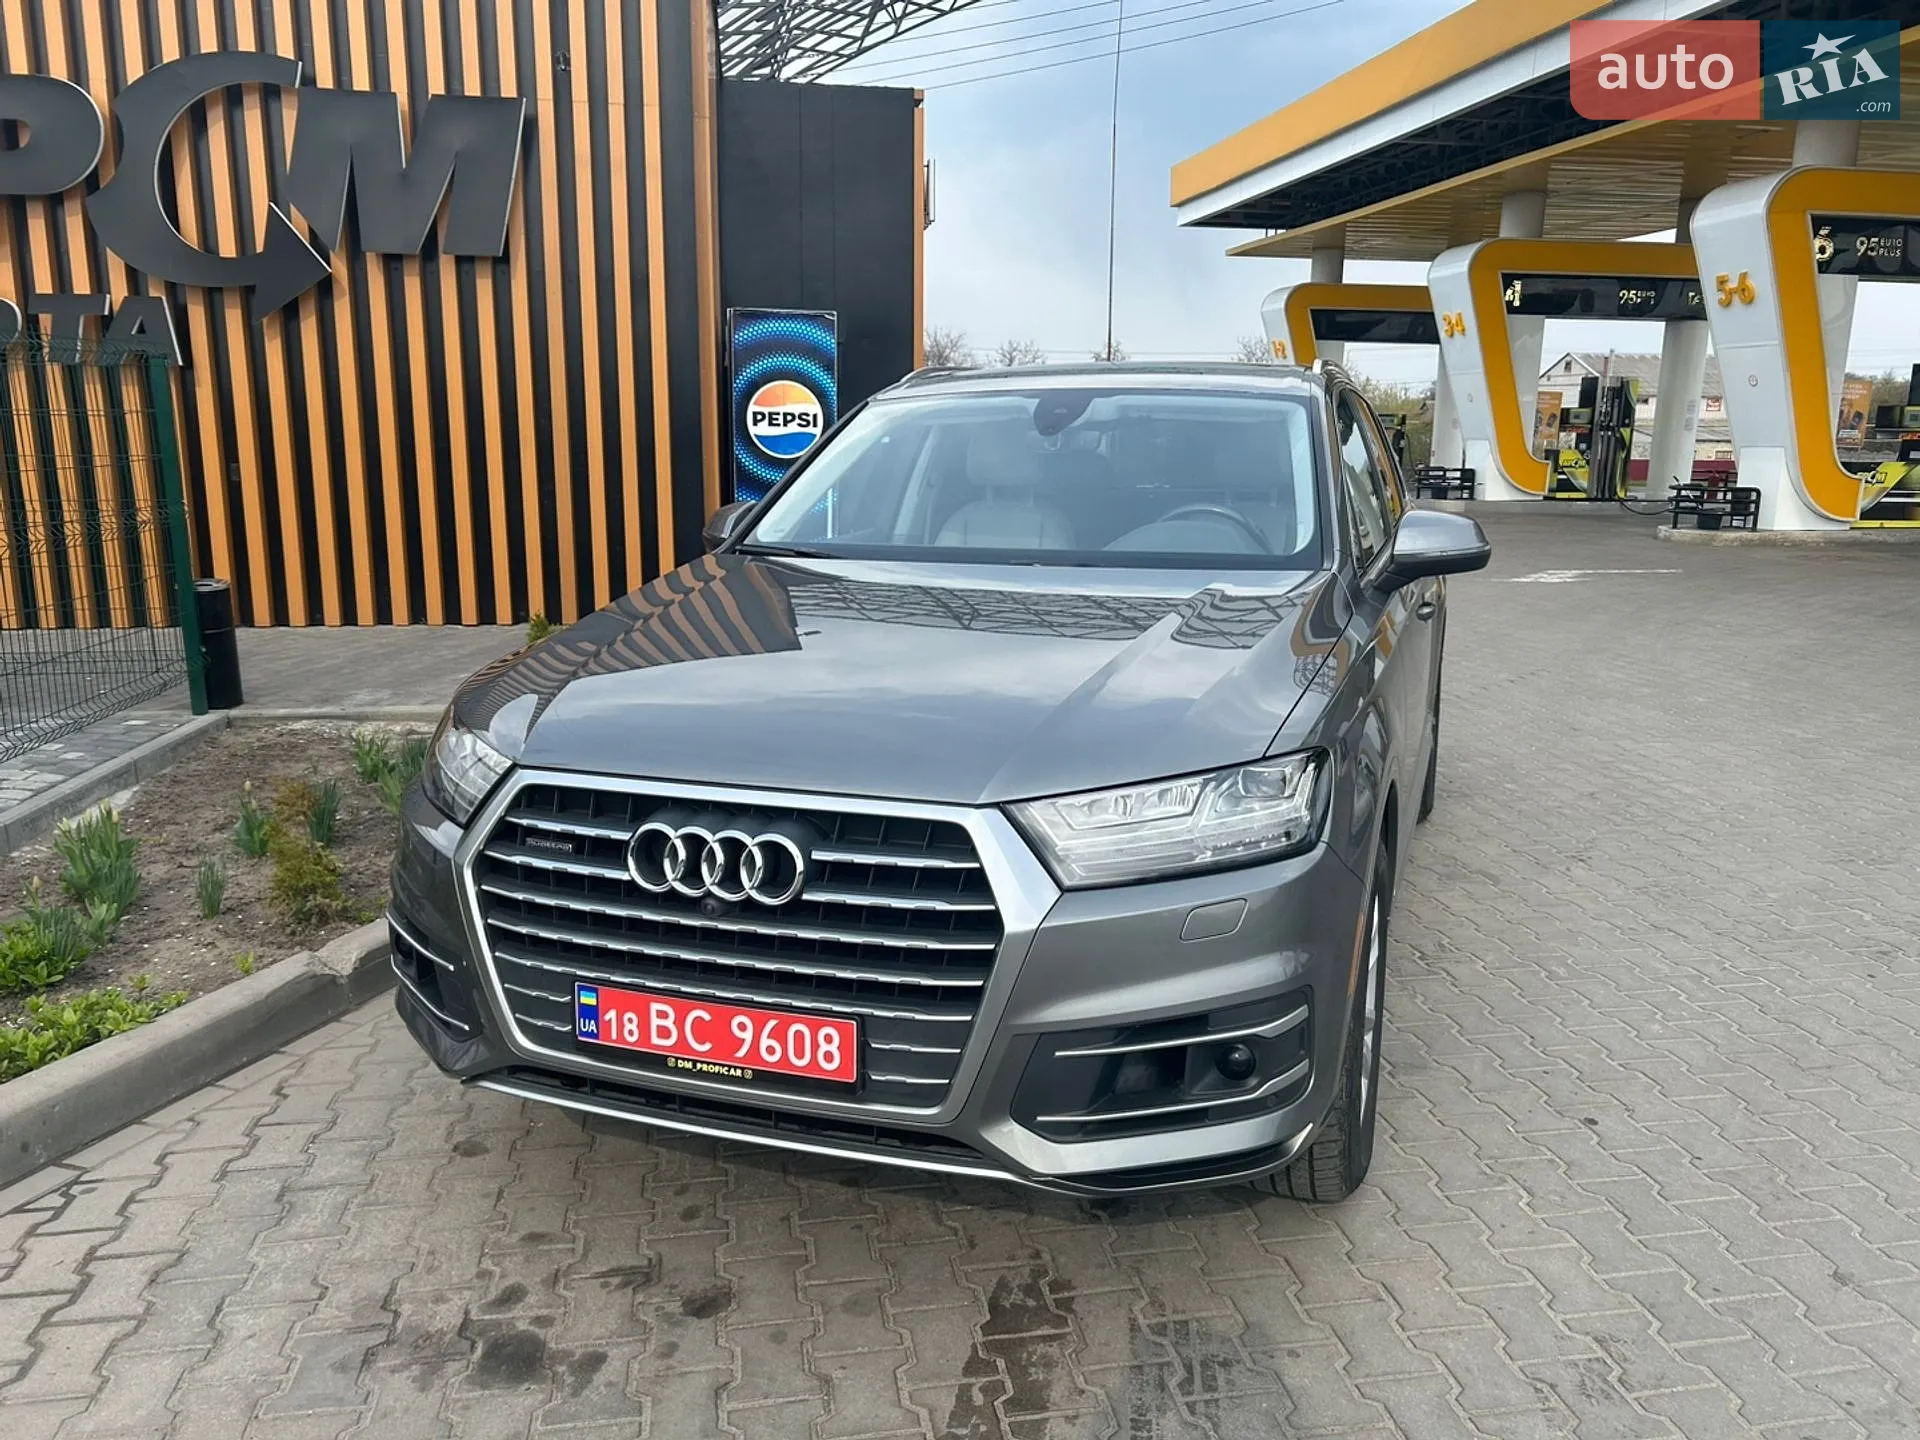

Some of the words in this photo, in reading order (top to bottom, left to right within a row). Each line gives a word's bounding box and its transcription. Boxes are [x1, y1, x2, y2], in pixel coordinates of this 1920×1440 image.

[1856, 236, 1880, 257] 95
[1879, 248, 1902, 257] PLUS
[1715, 271, 1756, 308] 5-6
[752, 411, 818, 428] PEPSI
[580, 1018, 597, 1034] UA
[603, 1008, 640, 1043] 18
[649, 1002, 712, 1052] BC
[730, 1014, 841, 1072] 9608
[677, 1059, 743, 1079] DM_PROFICAR
